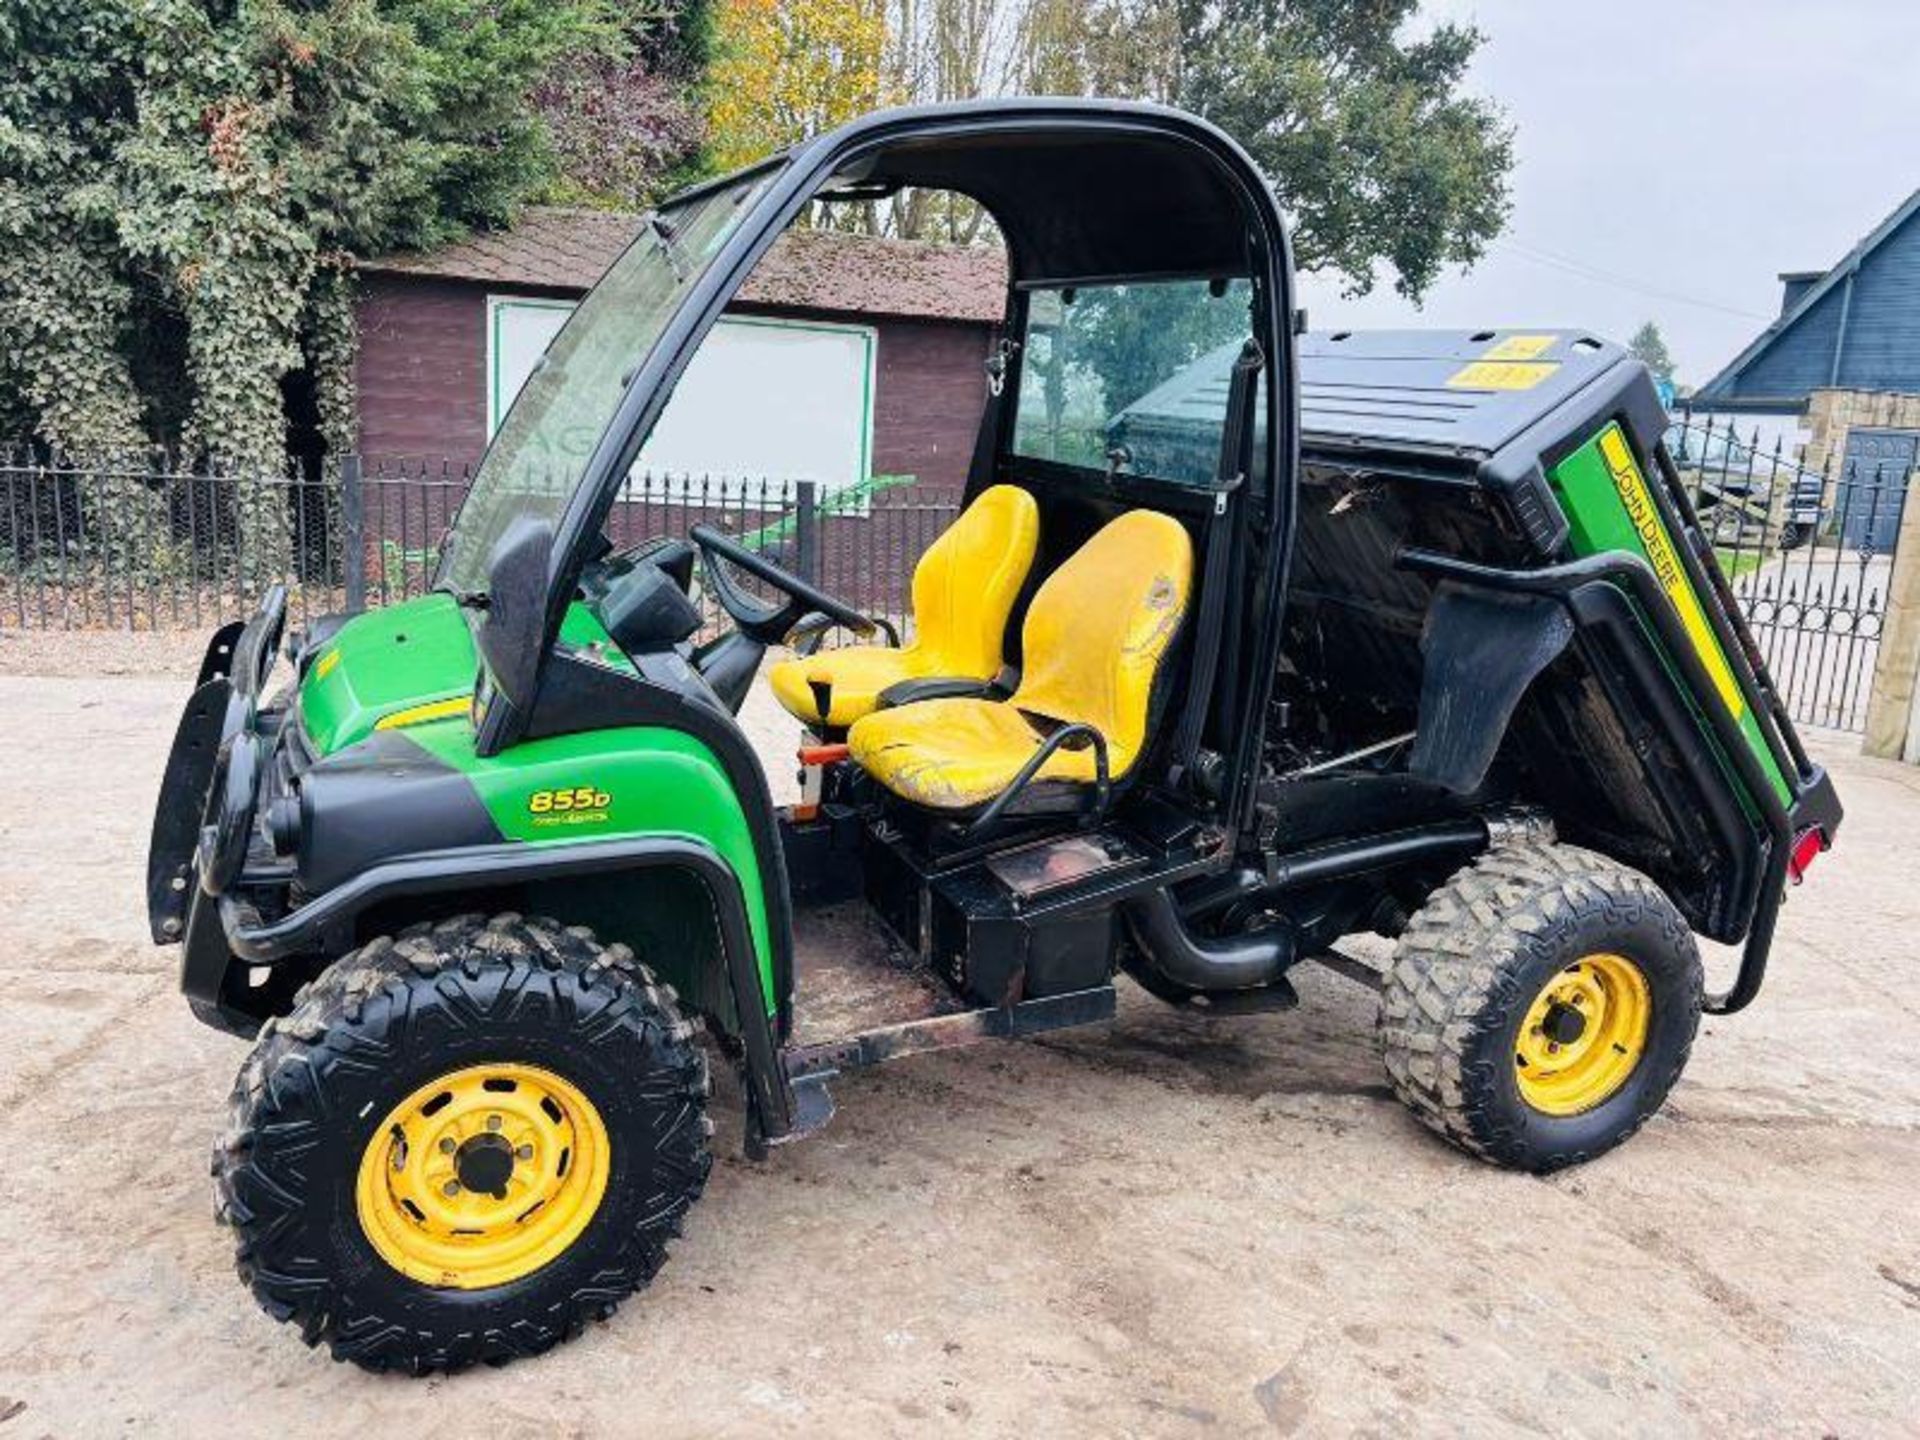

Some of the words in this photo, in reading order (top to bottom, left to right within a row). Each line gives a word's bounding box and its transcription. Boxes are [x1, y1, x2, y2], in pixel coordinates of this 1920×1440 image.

[1614, 465, 1645, 522] JOHN
[1641, 519, 1678, 587] DEERE
[529, 787, 611, 814] 855D
